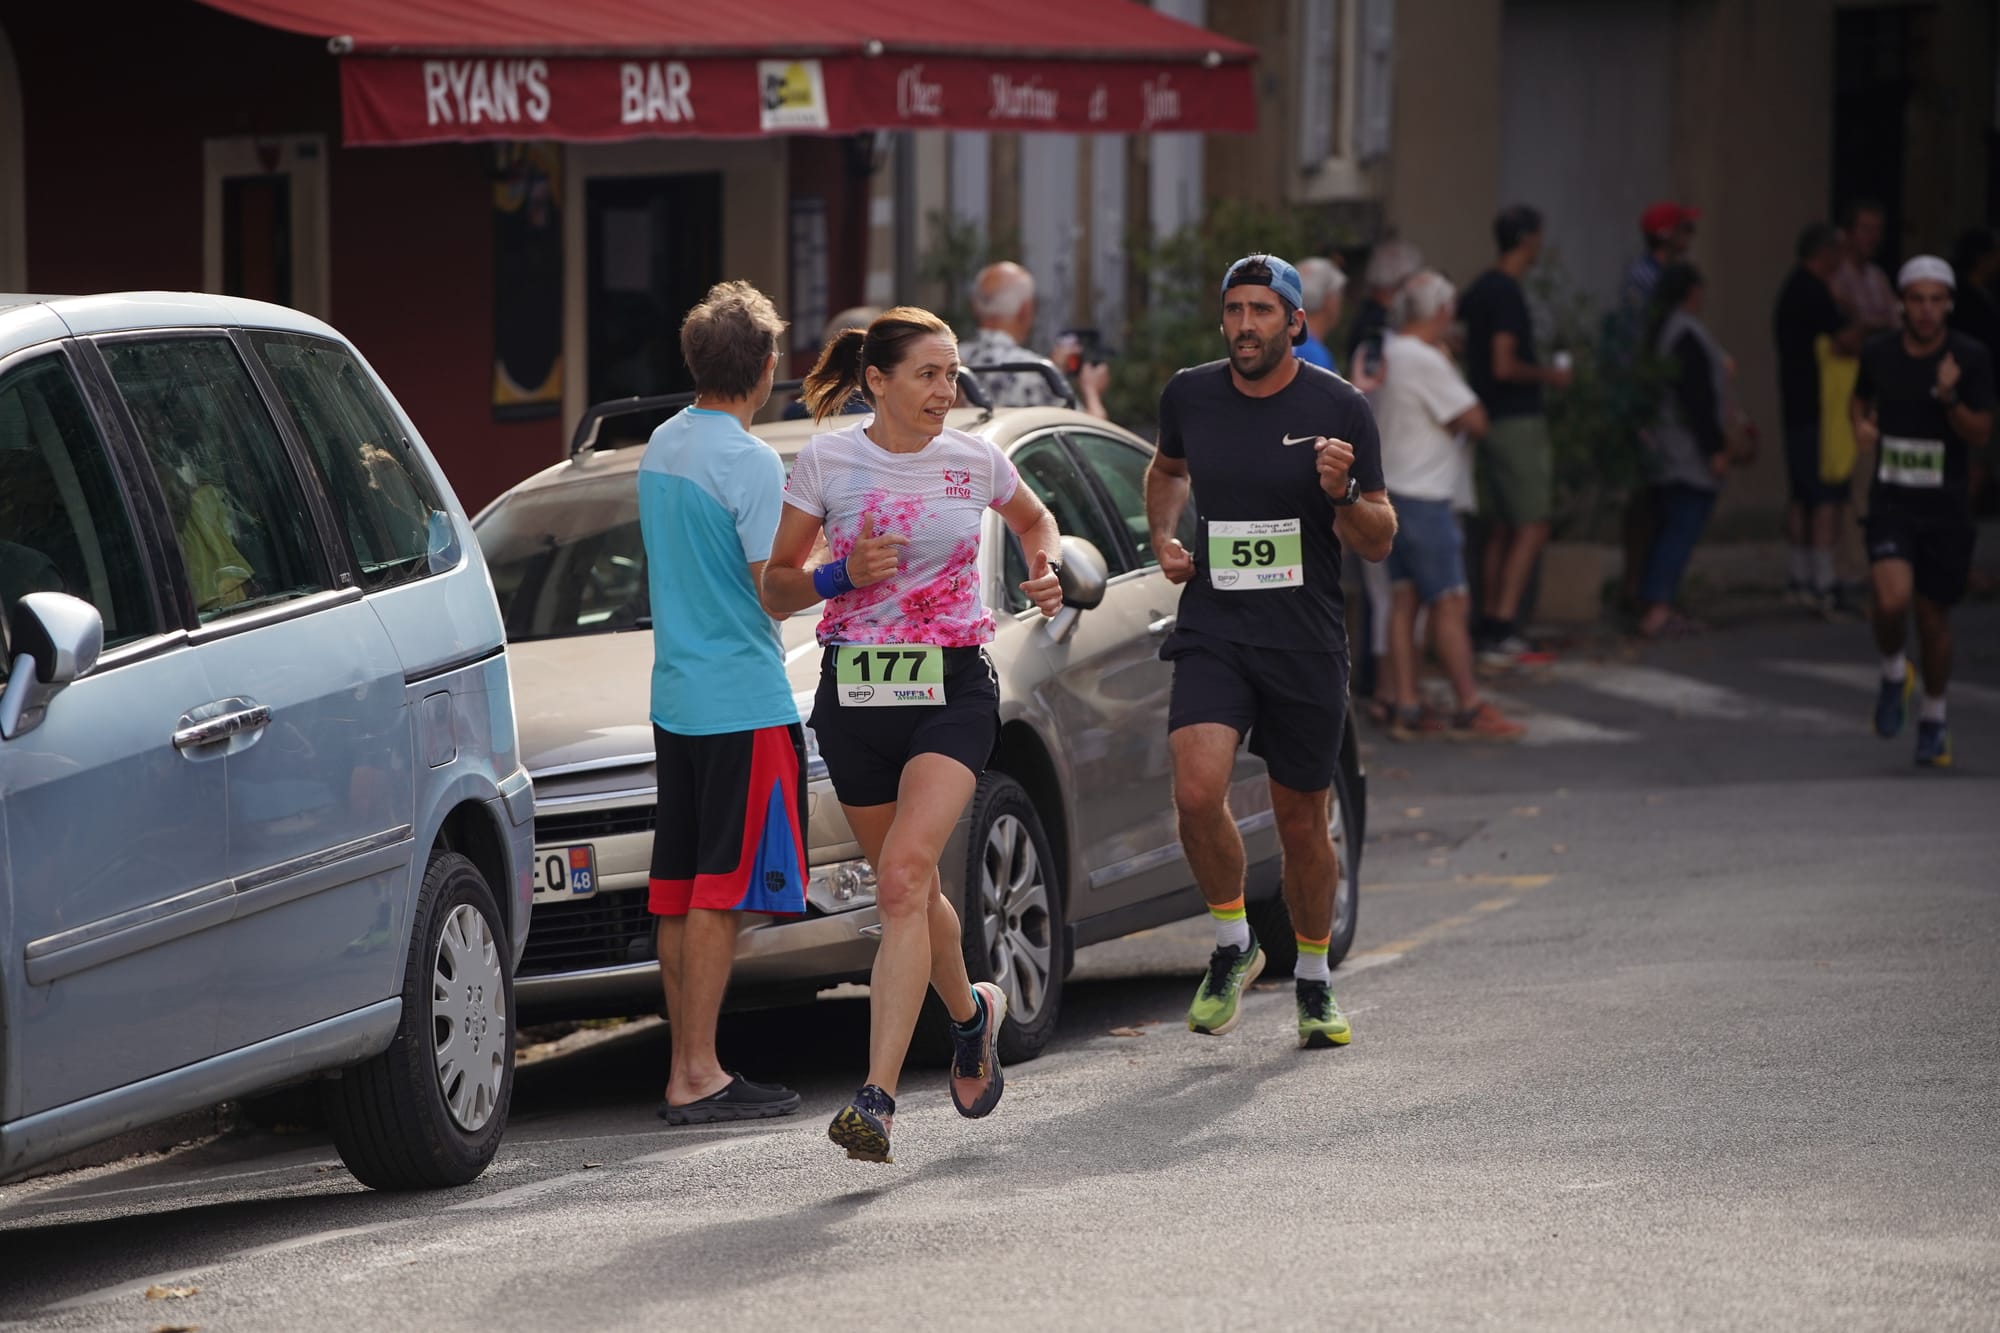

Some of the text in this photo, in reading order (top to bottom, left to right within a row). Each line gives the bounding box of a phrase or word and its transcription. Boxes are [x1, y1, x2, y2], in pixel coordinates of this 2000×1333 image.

[424, 60, 551, 125] RYAN'S
[621, 61, 696, 124] BAR
[897, 64, 943, 118] Chez
[1231, 539, 1276, 567] 59
[852, 650, 927, 682] 177
[573, 871, 591, 890] 48
